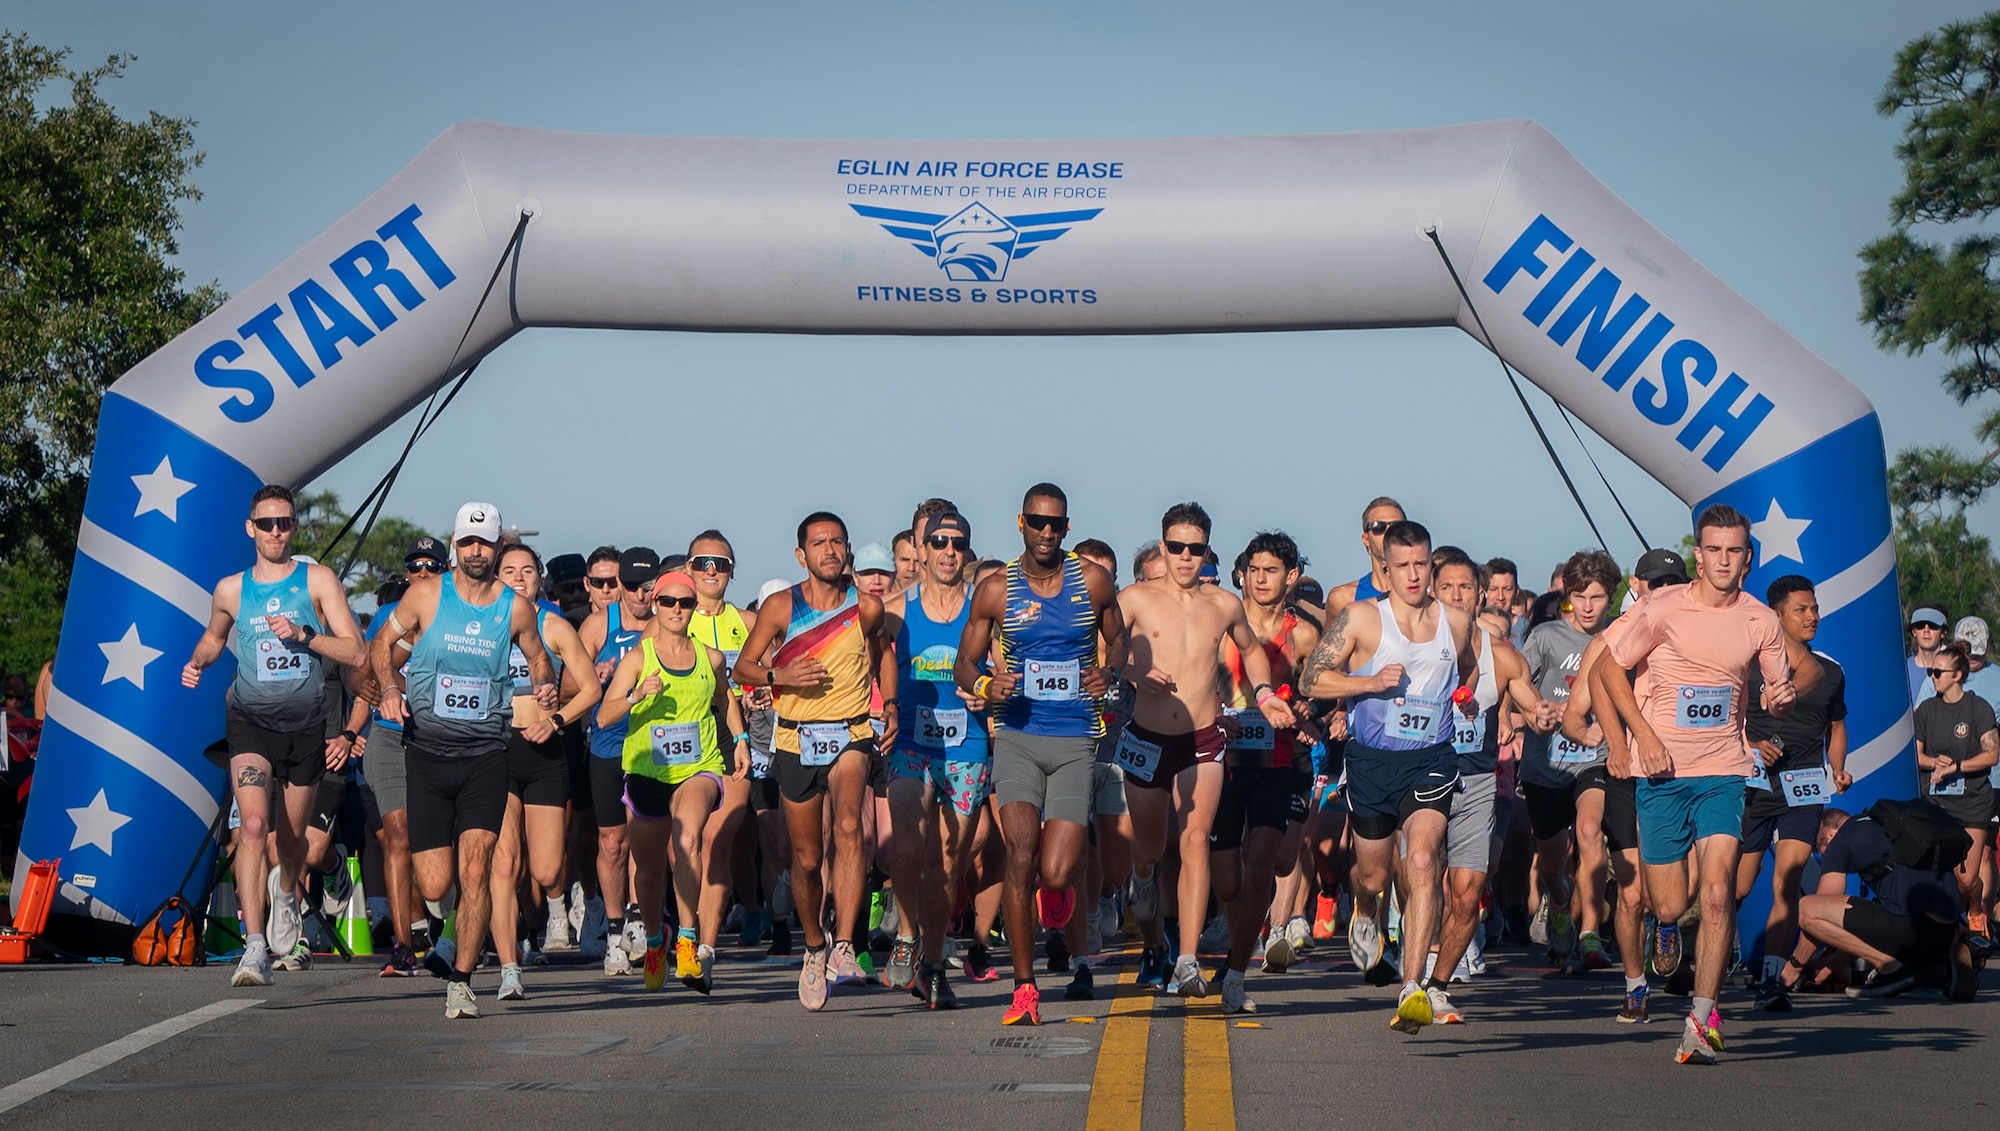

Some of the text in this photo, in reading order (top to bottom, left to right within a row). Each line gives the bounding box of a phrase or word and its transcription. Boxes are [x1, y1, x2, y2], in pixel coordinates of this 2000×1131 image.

[837, 159, 1124, 178] EGLIN AIR FORCE BASE
[847, 183, 1107, 198] DEPARTMENT OF THE AIR FORCE
[857, 285, 1097, 304] FITNESS & SPORTS
[194, 203, 457, 423] START
[1482, 213, 1776, 473] FINISH
[444, 633, 496, 649] RISING TIDE
[447, 644, 491, 656] RUNNING
[266, 655, 301, 670] 624
[1036, 678, 1068, 690] 148
[445, 693, 480, 709] 626
[1687, 704, 1722, 718] 608
[1399, 713, 1430, 730] 317
[923, 724, 957, 738] 230
[663, 741, 692, 755] 135
[812, 740, 839, 755] 136
[1119, 749, 1147, 768] 519
[1793, 784, 1820, 797] 653
